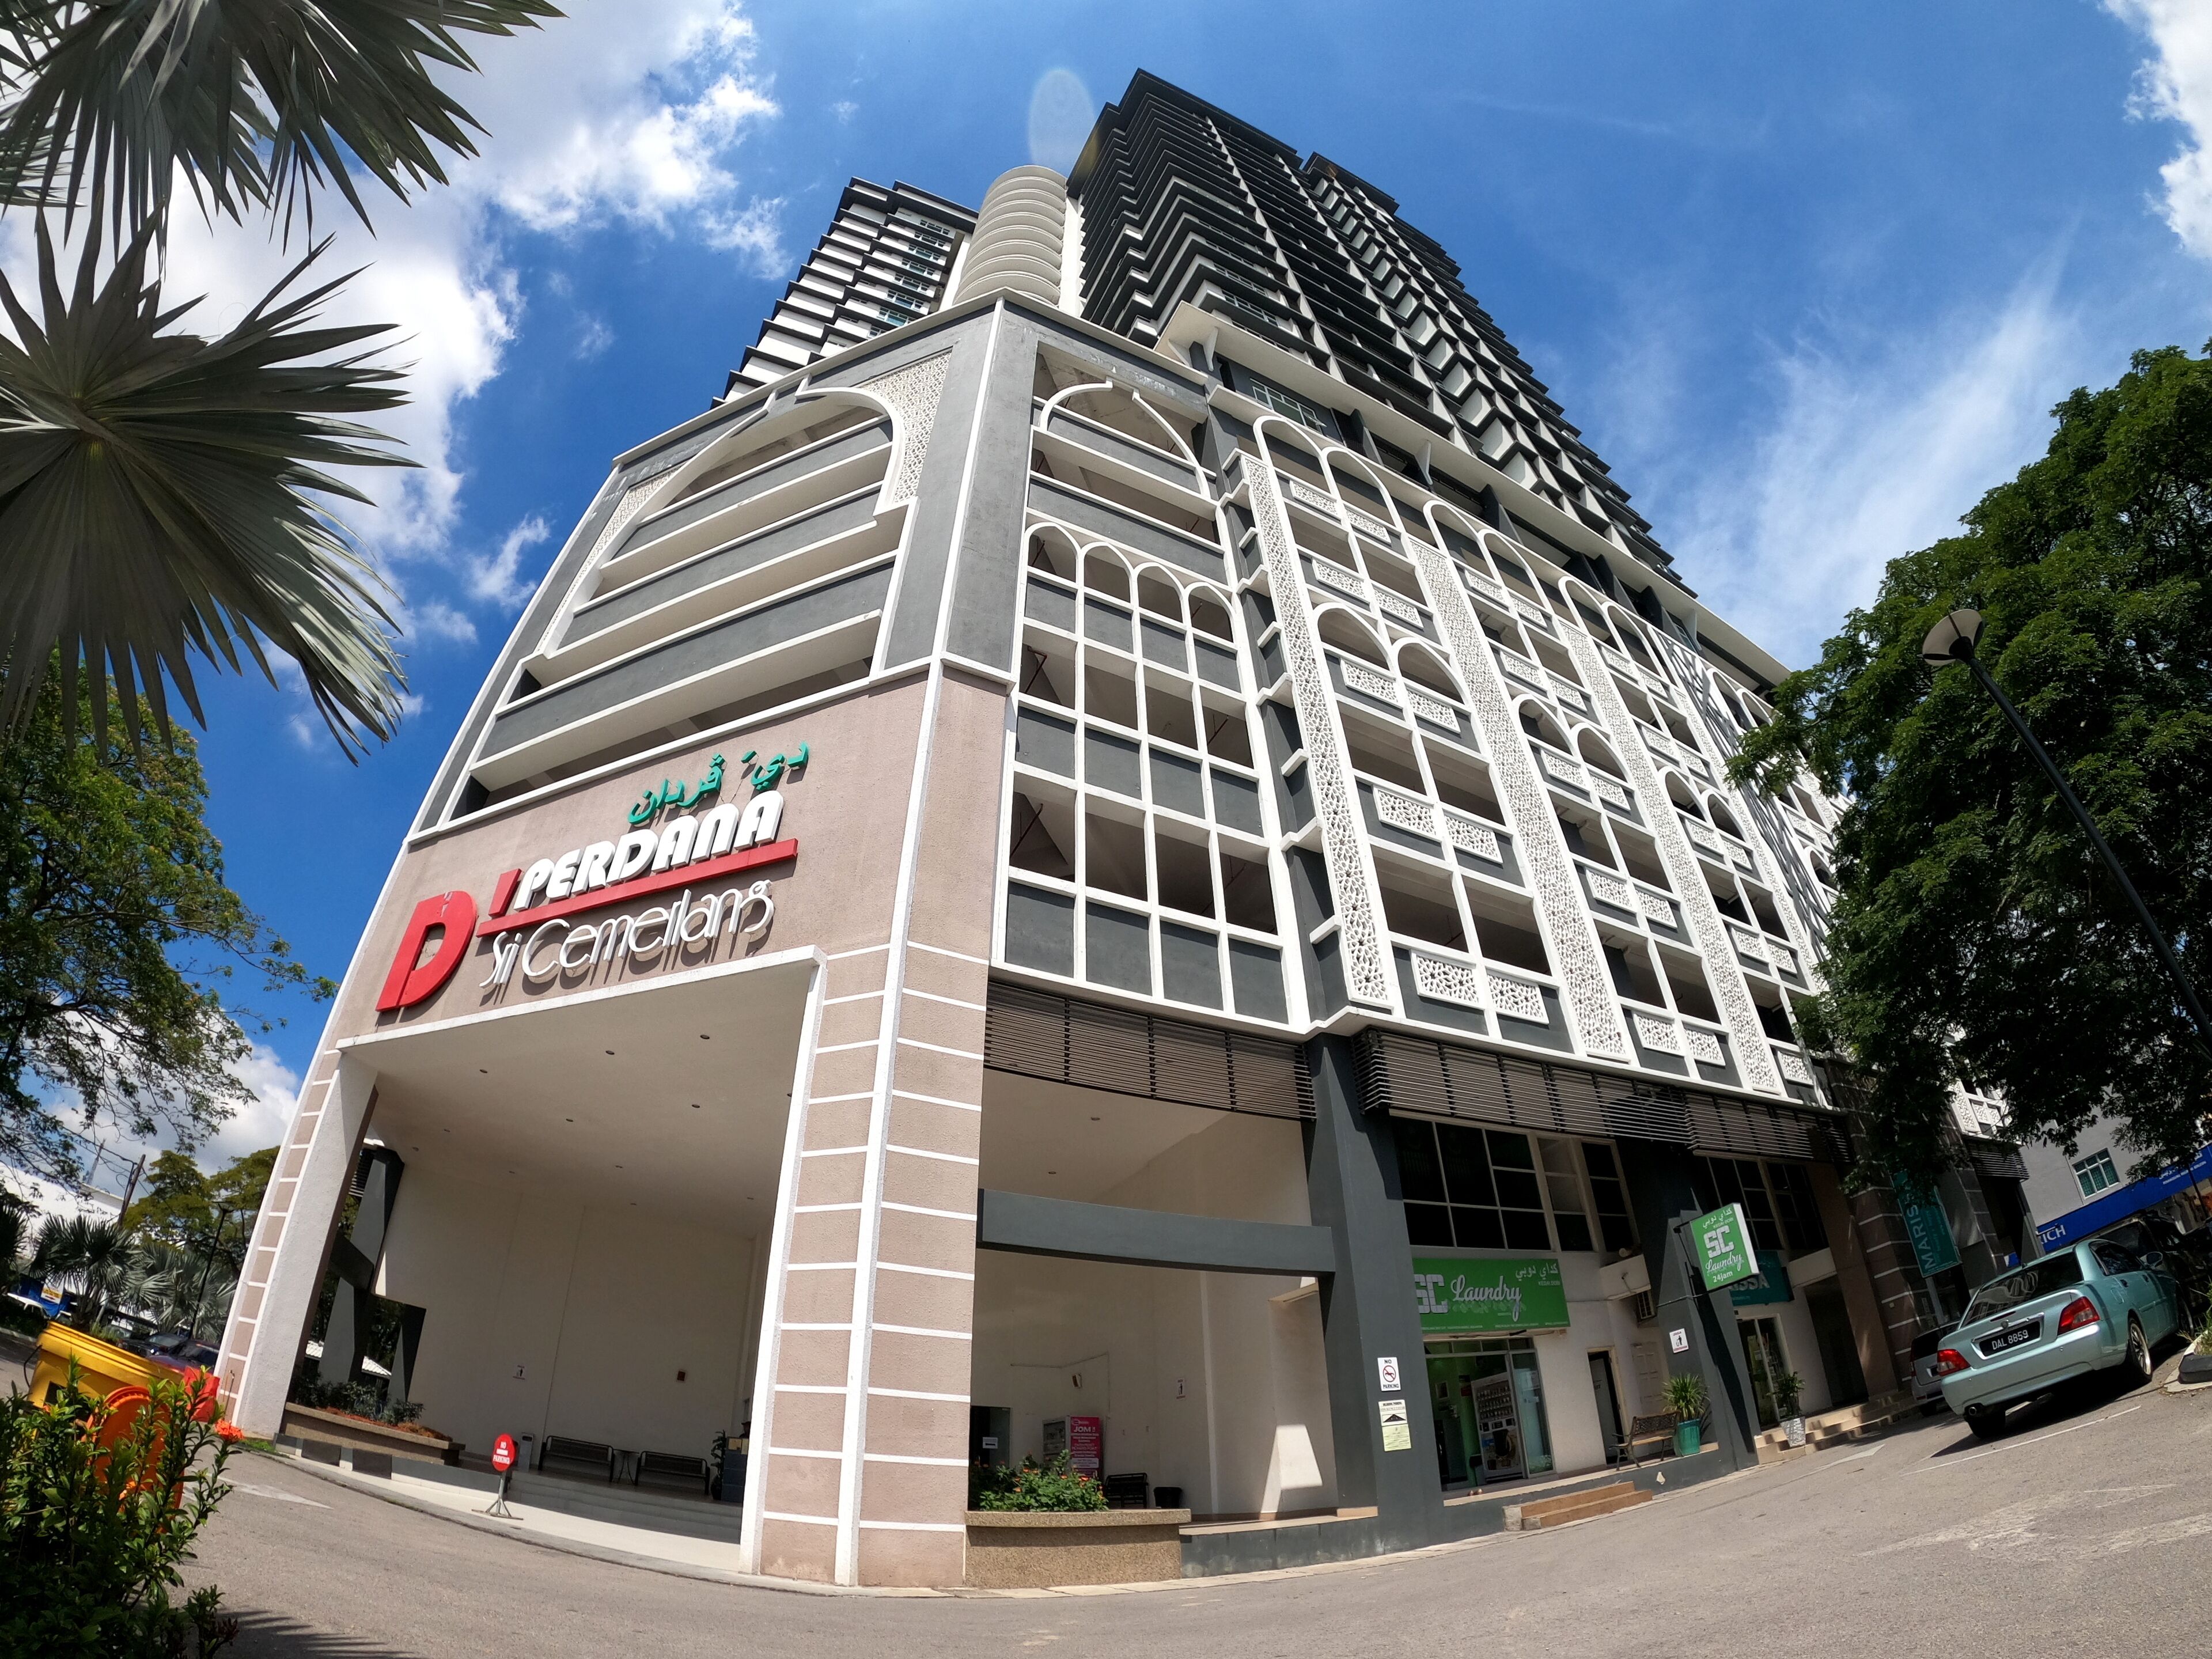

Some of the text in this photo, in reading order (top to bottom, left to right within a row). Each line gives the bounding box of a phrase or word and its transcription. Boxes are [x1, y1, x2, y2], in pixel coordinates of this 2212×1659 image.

[479, 879, 774, 987] Sri Cemerlang
[1703, 1225, 1734, 1258] SC
[1706, 1252, 1742, 1271] Laundry
[1450, 1274, 1522, 1321] Laundry
[1991, 1330, 2029, 1350] DAL 8859
